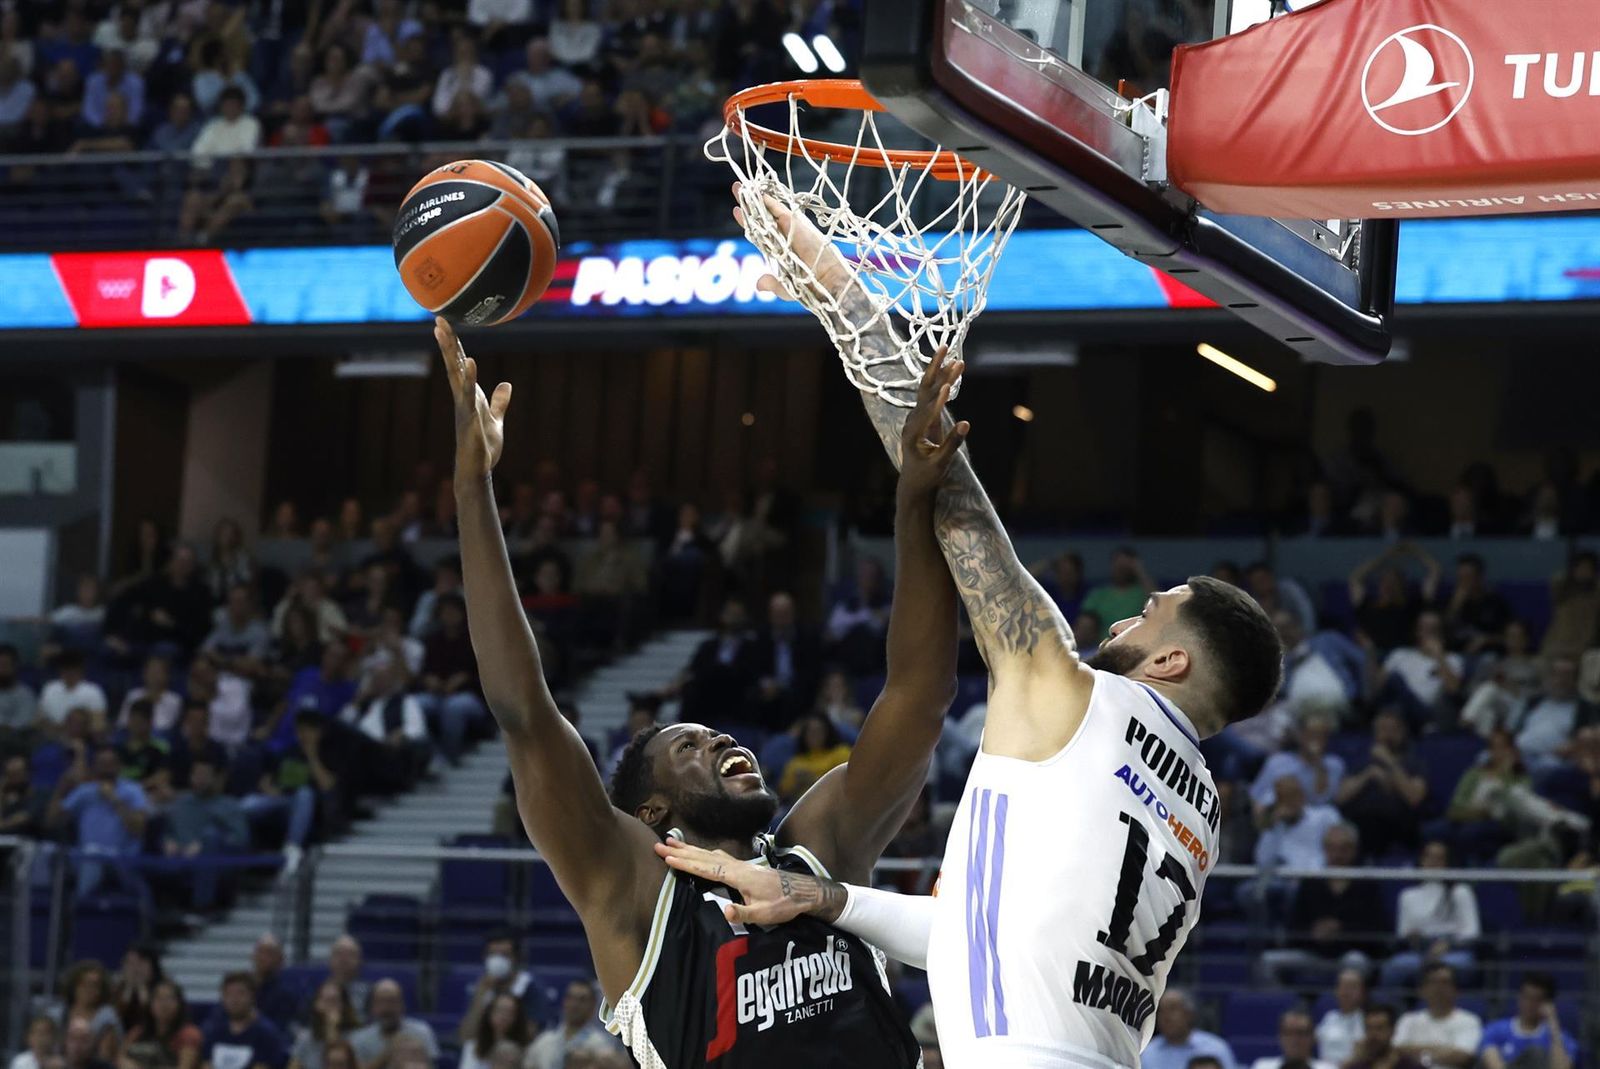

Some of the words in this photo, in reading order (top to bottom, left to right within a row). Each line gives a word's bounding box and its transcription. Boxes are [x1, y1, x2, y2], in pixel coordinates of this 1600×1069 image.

[418, 191, 466, 212] AIRLINES
[1371, 195, 1525, 211] AIRLINES
[1537, 192, 1600, 204] ISH
[571, 240, 778, 306] PASIÓN
[1124, 715, 1220, 834] POIRIER
[1114, 764, 1208, 872] AUTOHERO
[1096, 810, 1196, 976] 17
[785, 998, 833, 1024] ZANETTI
